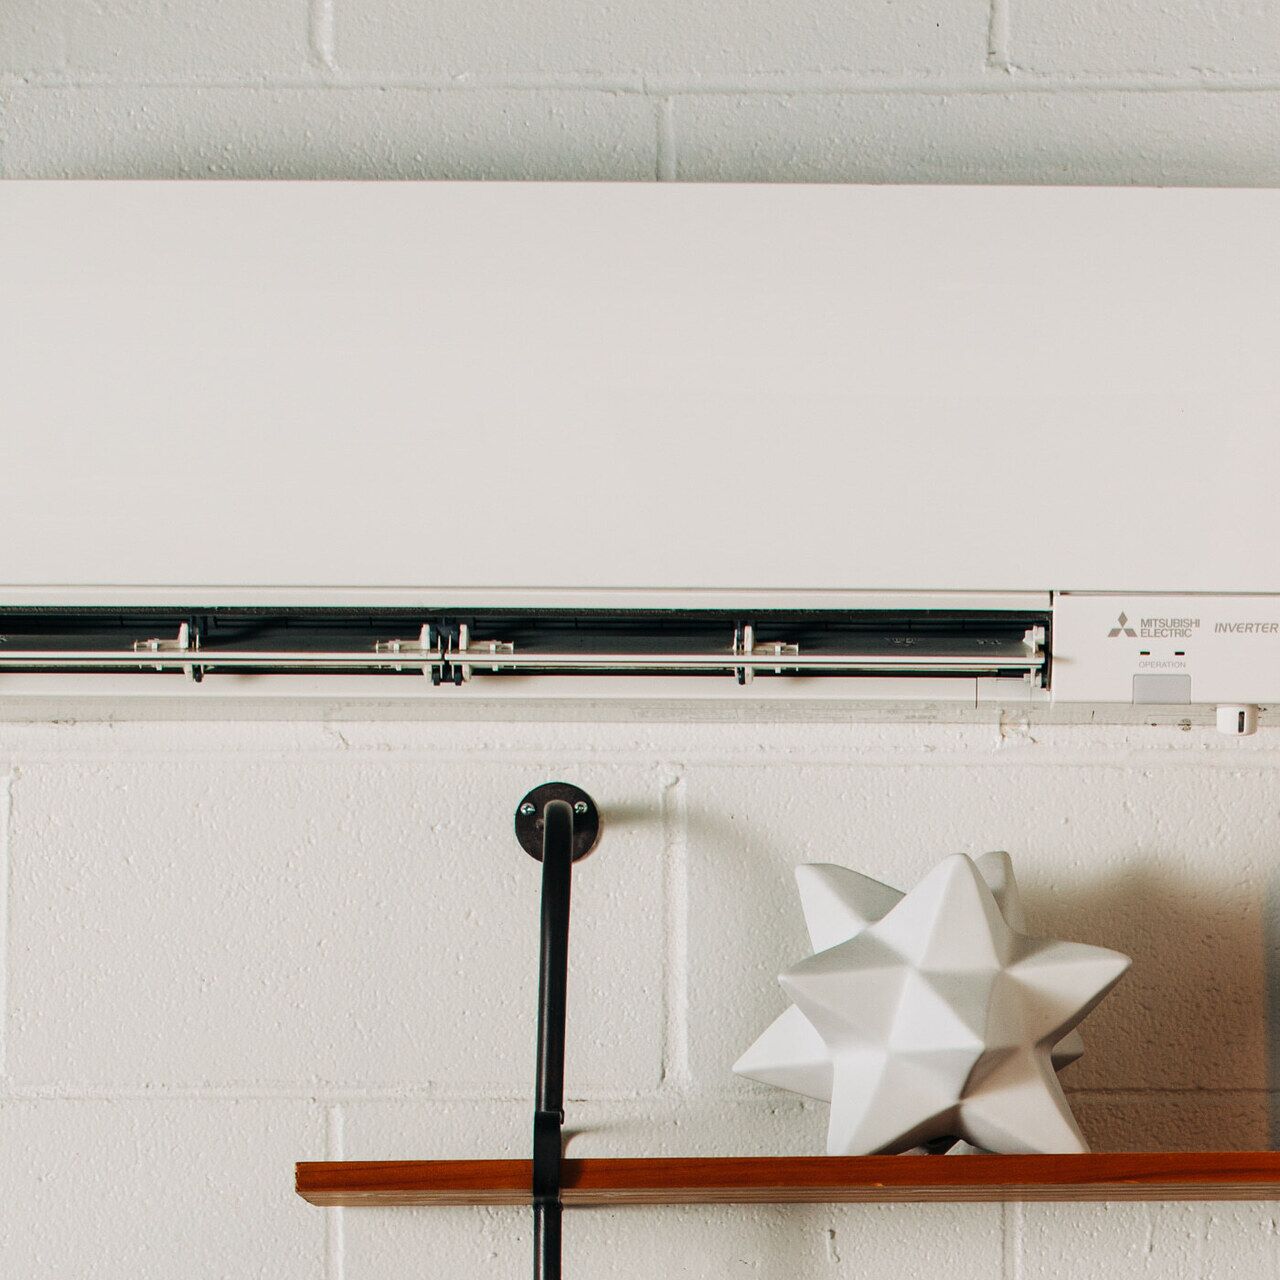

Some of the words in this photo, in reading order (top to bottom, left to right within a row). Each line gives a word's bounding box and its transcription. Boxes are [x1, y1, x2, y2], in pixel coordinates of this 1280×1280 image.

[1140, 618, 1201, 629] MITSUBISHI
[1214, 622, 1279, 634] INVERTER
[1140, 628, 1192, 638] ELECTRIC
[1138, 660, 1187, 669] OPERATION
